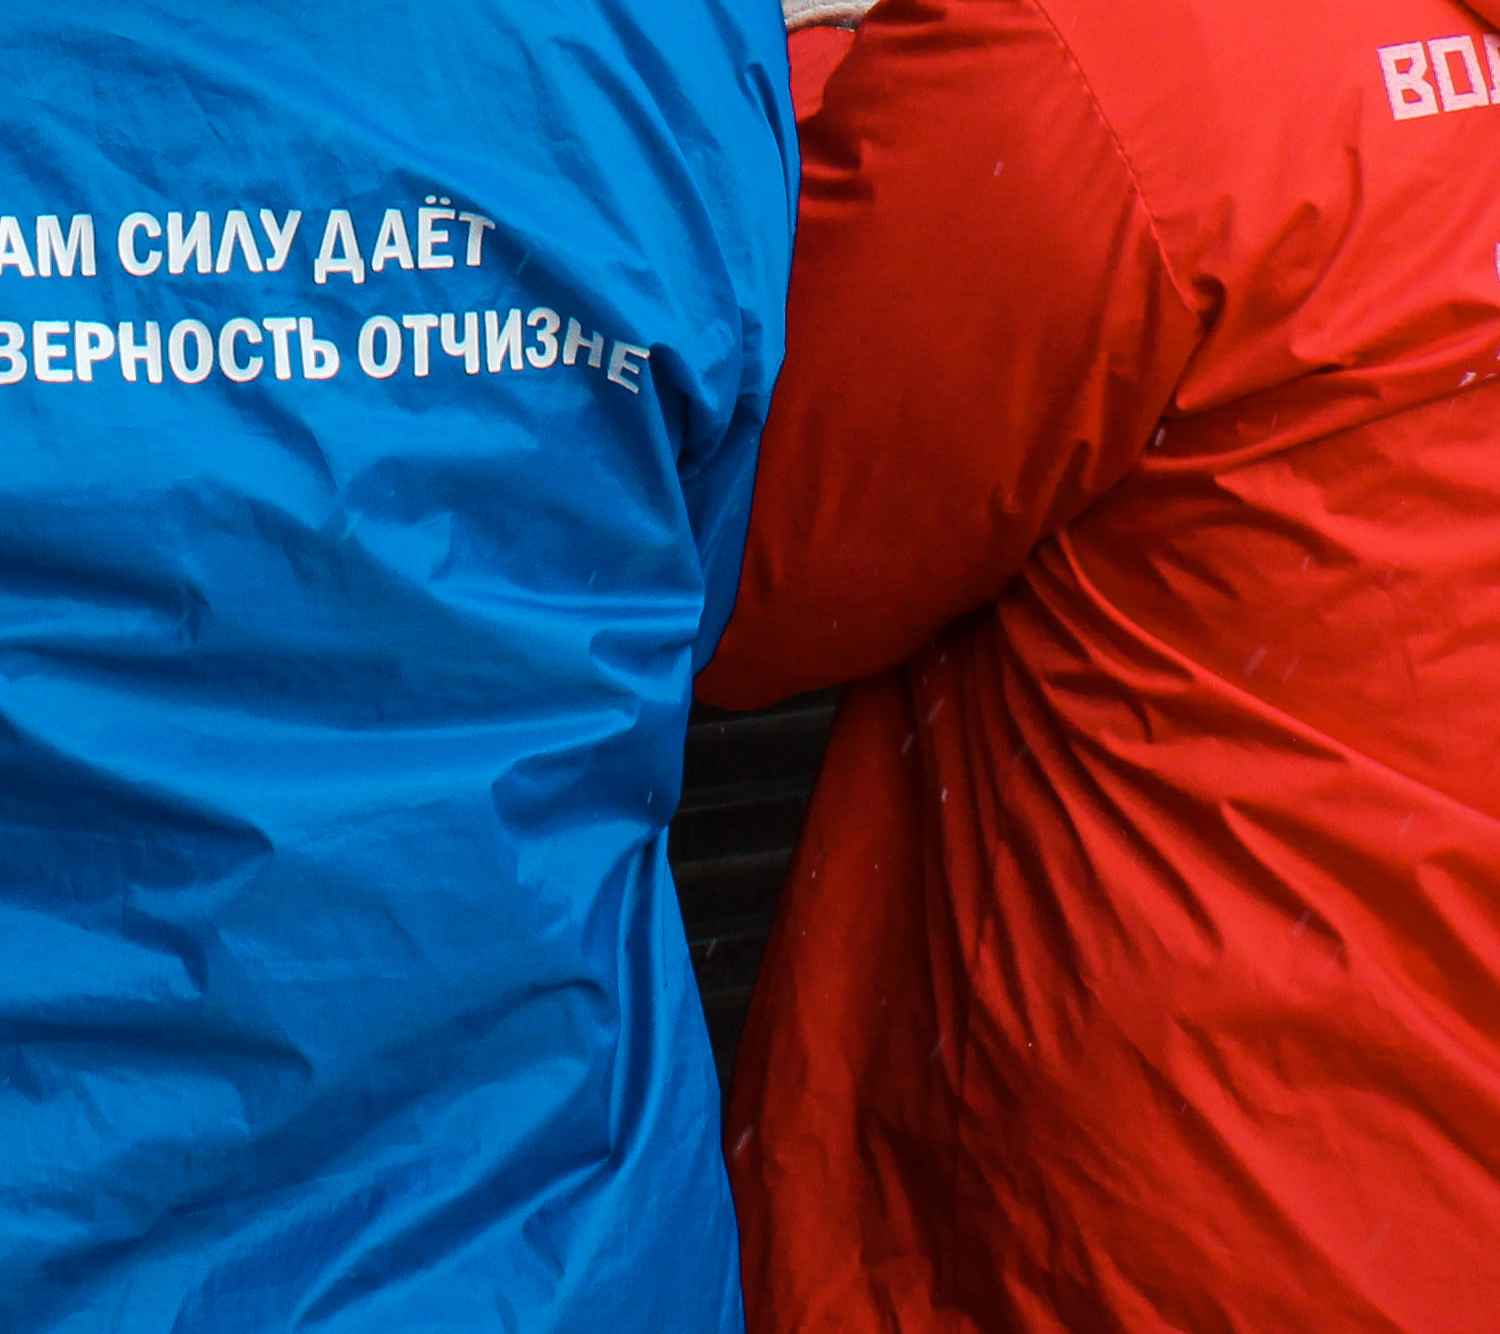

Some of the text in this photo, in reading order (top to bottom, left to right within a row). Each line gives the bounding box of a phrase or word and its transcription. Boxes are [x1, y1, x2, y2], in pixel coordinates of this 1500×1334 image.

[117, 208, 302, 275] СИЛУ
[313, 195, 497, 284] ДАЁТ
[358, 306, 651, 394] ОТЧИЗНЕ
